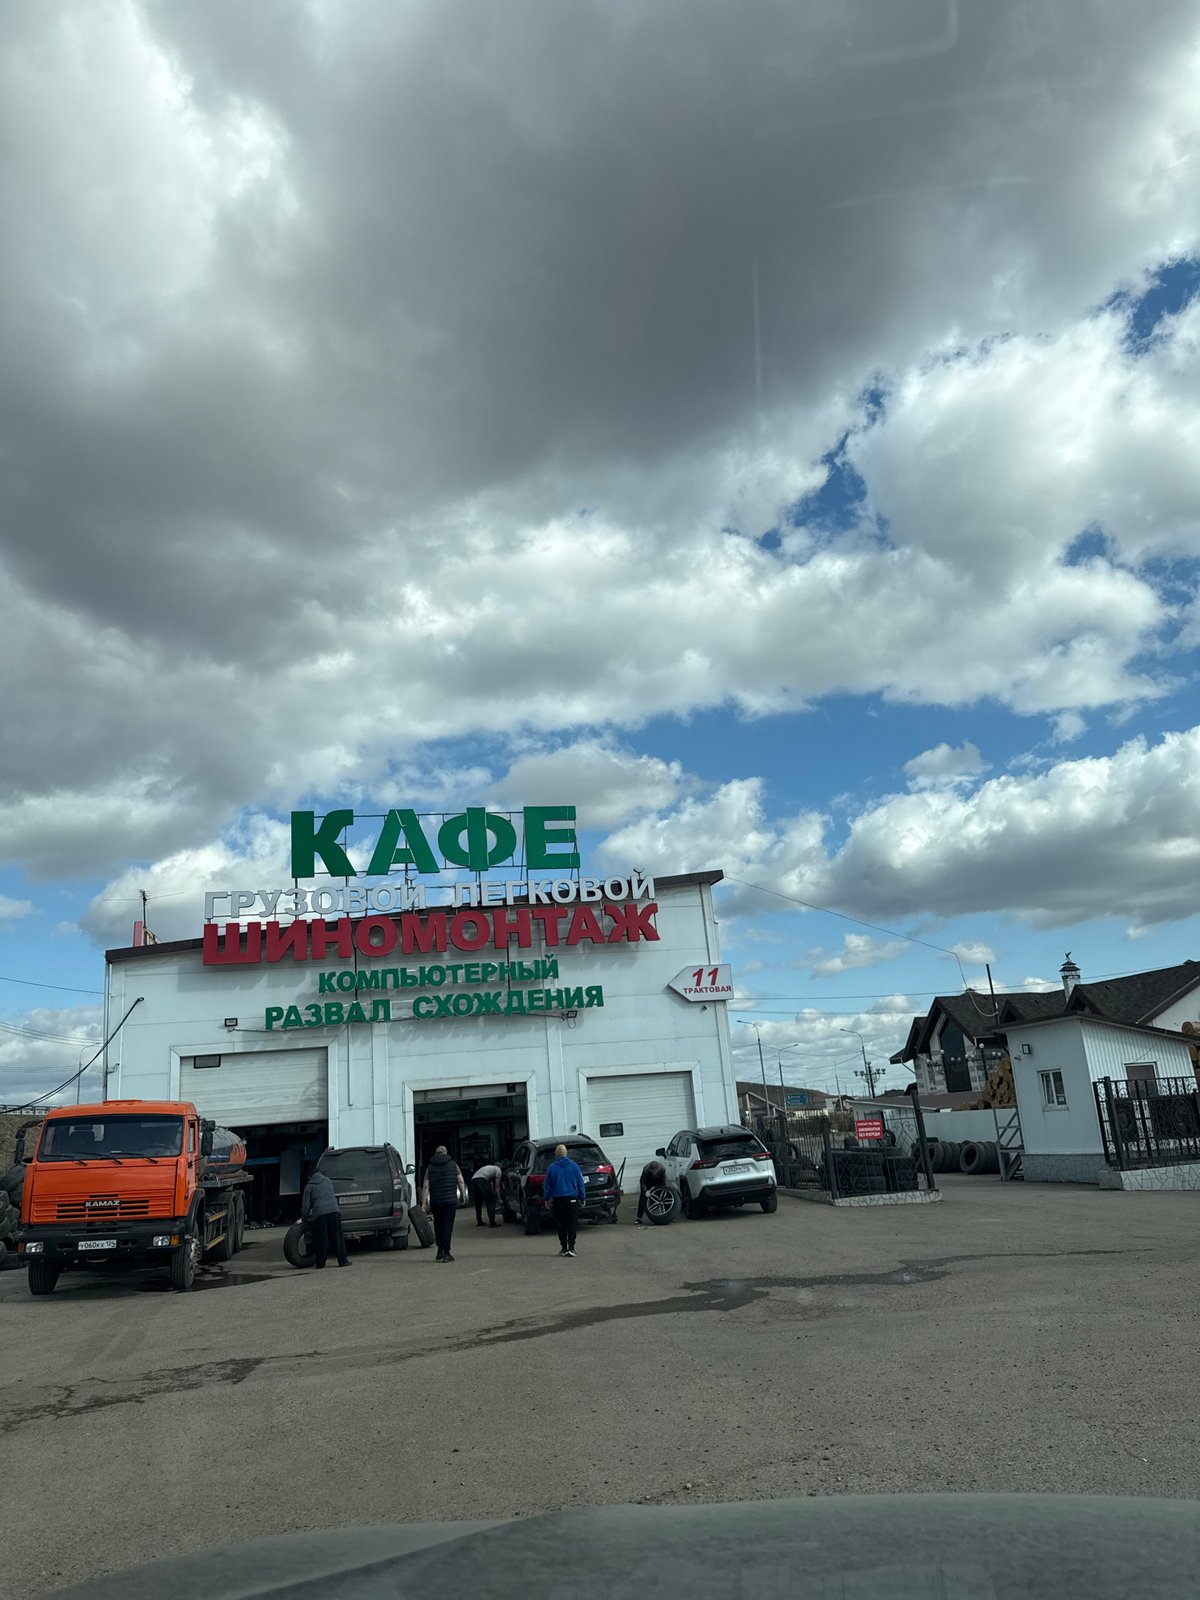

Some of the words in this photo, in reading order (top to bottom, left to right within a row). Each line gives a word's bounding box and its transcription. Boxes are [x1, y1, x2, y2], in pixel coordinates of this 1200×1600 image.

[291, 806, 580, 878] КАФЕ
[204, 875, 427, 919] ГРУЗОВОЙ
[451, 868, 656, 908] ЛЕГКОВОЙ
[203, 903, 660, 966] ШИНОМОНТАЖ
[318, 954, 560, 993] КОМПЬЮТЕРНЫЙ
[683, 986, 732, 994] ТРАКТОВАЯ
[692, 967, 719, 987] 11
[265, 999, 391, 1031] РАЗВАЛ
[412, 985, 605, 1020] СХОЖДЕНИЯ
